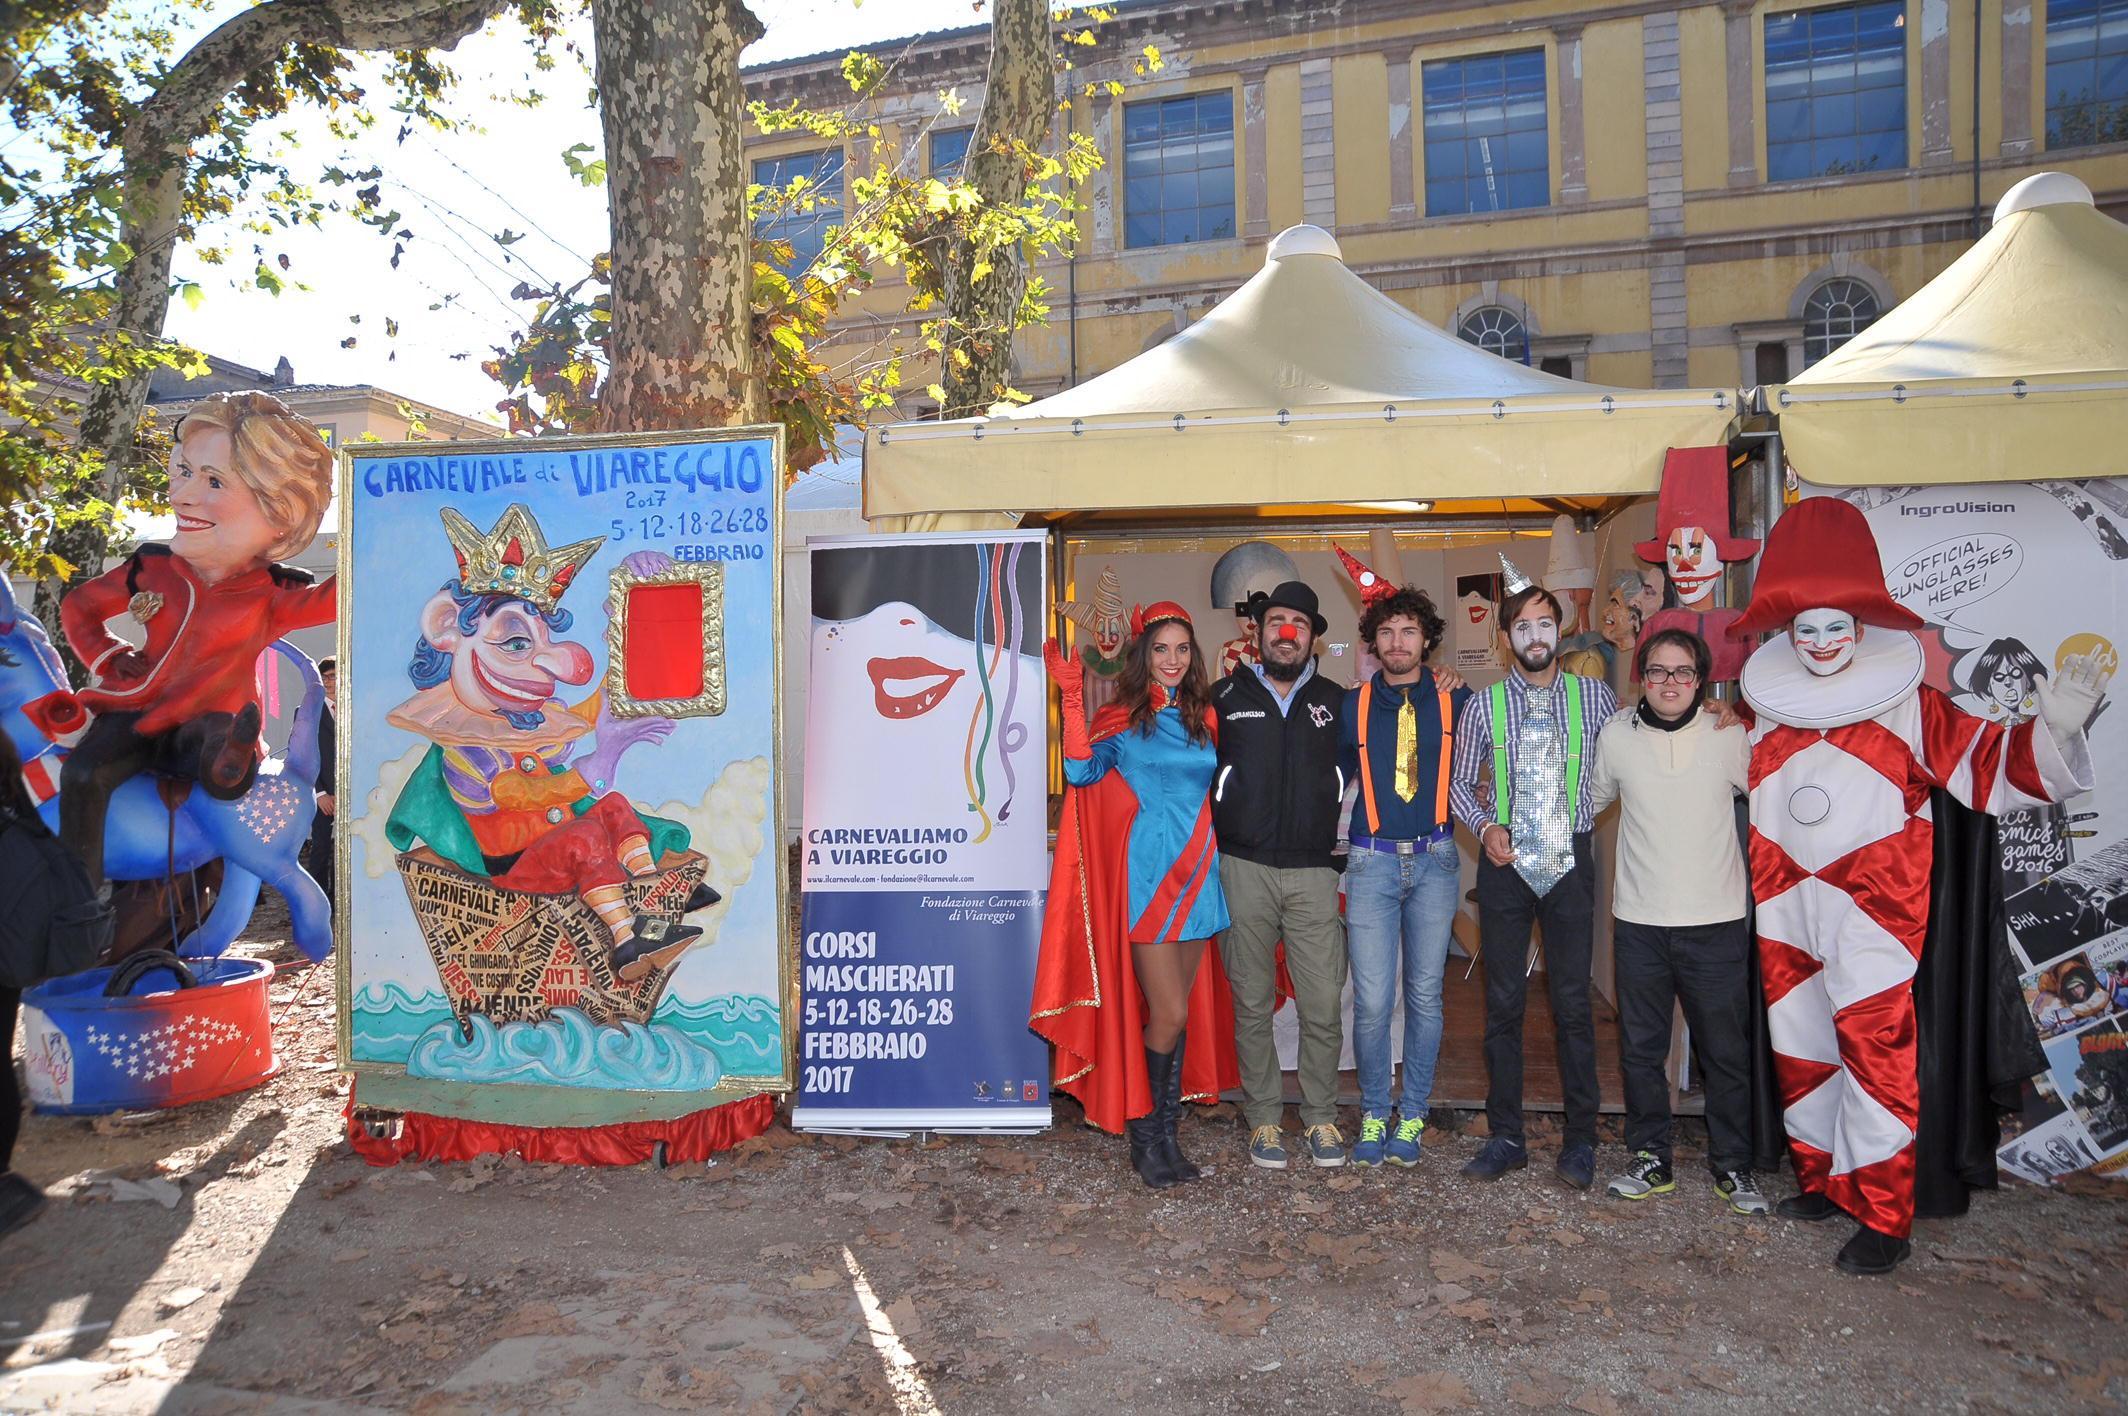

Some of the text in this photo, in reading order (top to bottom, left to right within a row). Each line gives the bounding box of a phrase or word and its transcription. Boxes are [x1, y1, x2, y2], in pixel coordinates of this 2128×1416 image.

[364, 446, 763, 498] CARNEVALE di VIAREGGIO
[625, 489, 667, 509] 2017
[1900, 501, 2016, 518] IngroVision
[674, 544, 764, 561] FEBBRAIO
[1903, 538, 1985, 579] OFFICIAL
[1888, 543, 2014, 602] SUNGLASSES
[1928, 571, 1988, 607] HERE!
[808, 828, 968, 845] CARNEVALIAMO
[807, 849, 948, 865] A VIAREGGIO
[2001, 839, 2066, 871] games
[2015, 859, 2056, 872] 2016
[806, 874, 876, 884] www.ilcarnevale.com
[417, 877, 501, 917] CARNEVALE
[920, 895, 1045, 908] Fondazione Carnevale
[948, 909, 1016, 925] di Viareggio
[806, 931, 876, 959] CORSI
[805, 964, 955, 992] MASCHERATI
[804, 998, 954, 1026] 5-12-18-26-28
[804, 1032, 928, 1060] FEBBRAIO
[804, 1066, 855, 1093] 2017
